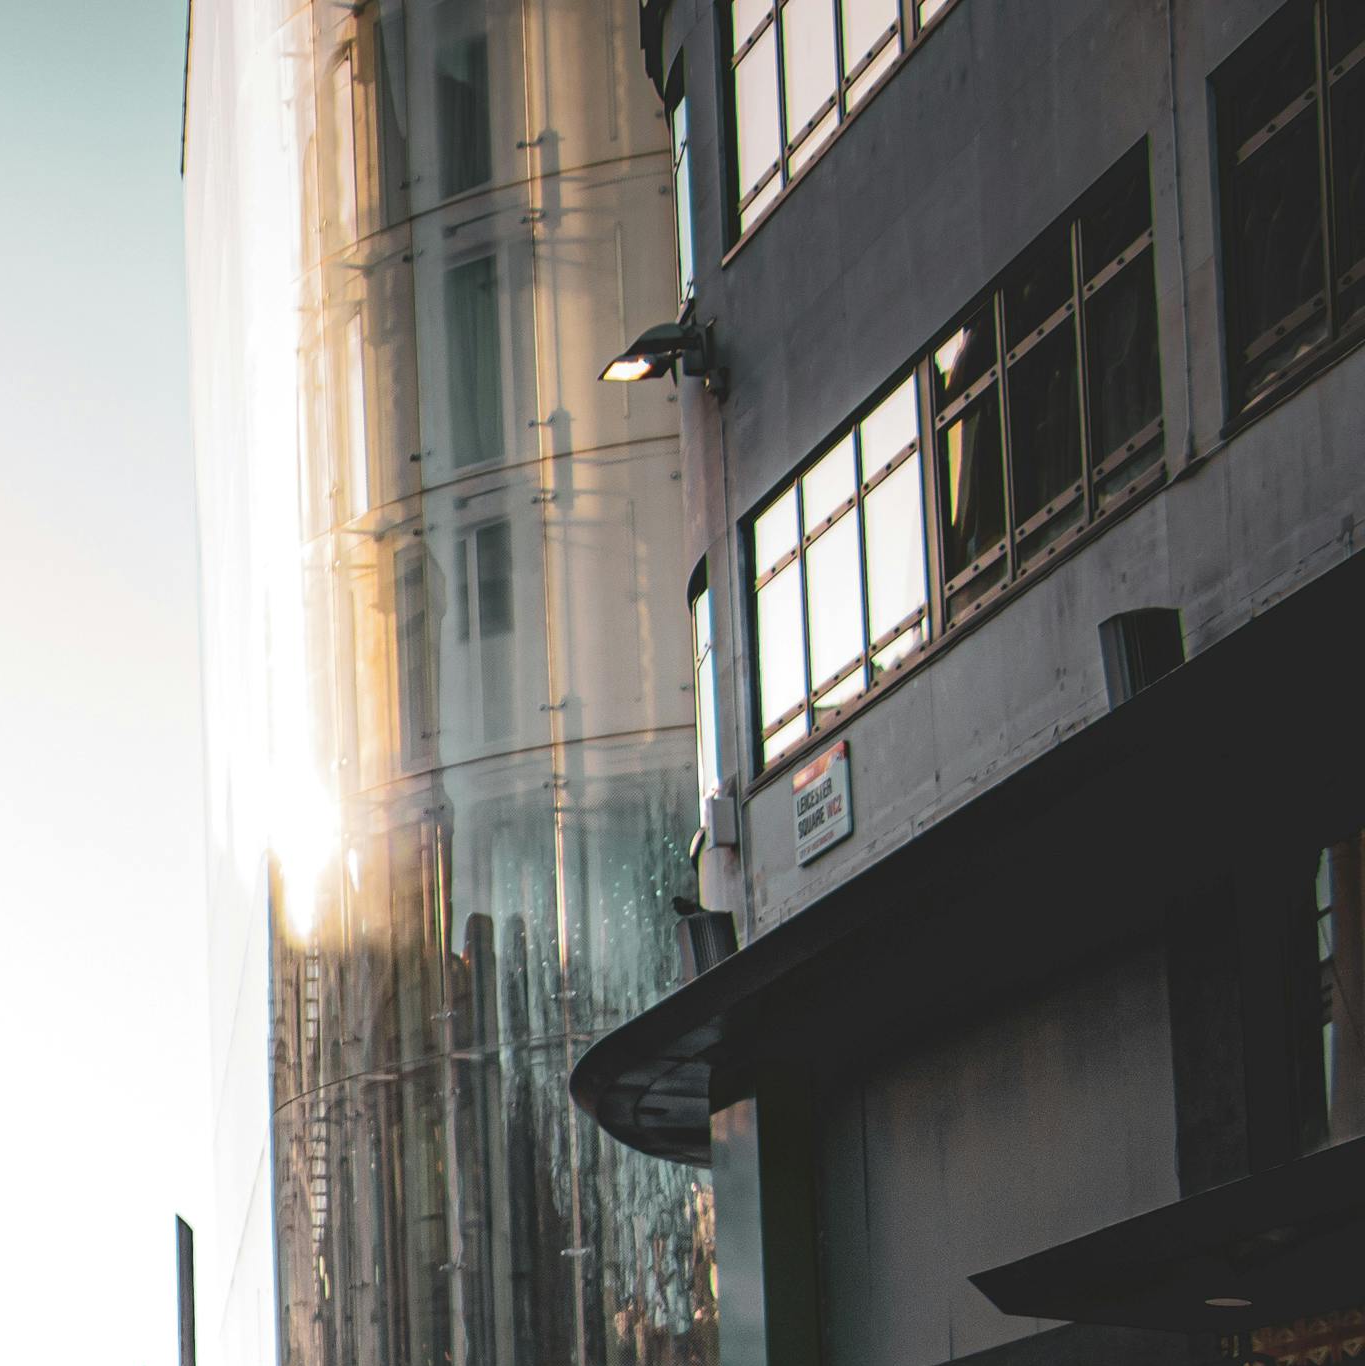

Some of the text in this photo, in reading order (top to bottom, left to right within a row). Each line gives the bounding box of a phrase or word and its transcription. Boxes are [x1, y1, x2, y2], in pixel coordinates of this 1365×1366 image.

[797, 777, 832, 817] LEICESTER
[798, 794, 843, 840] SQUARE WC2
